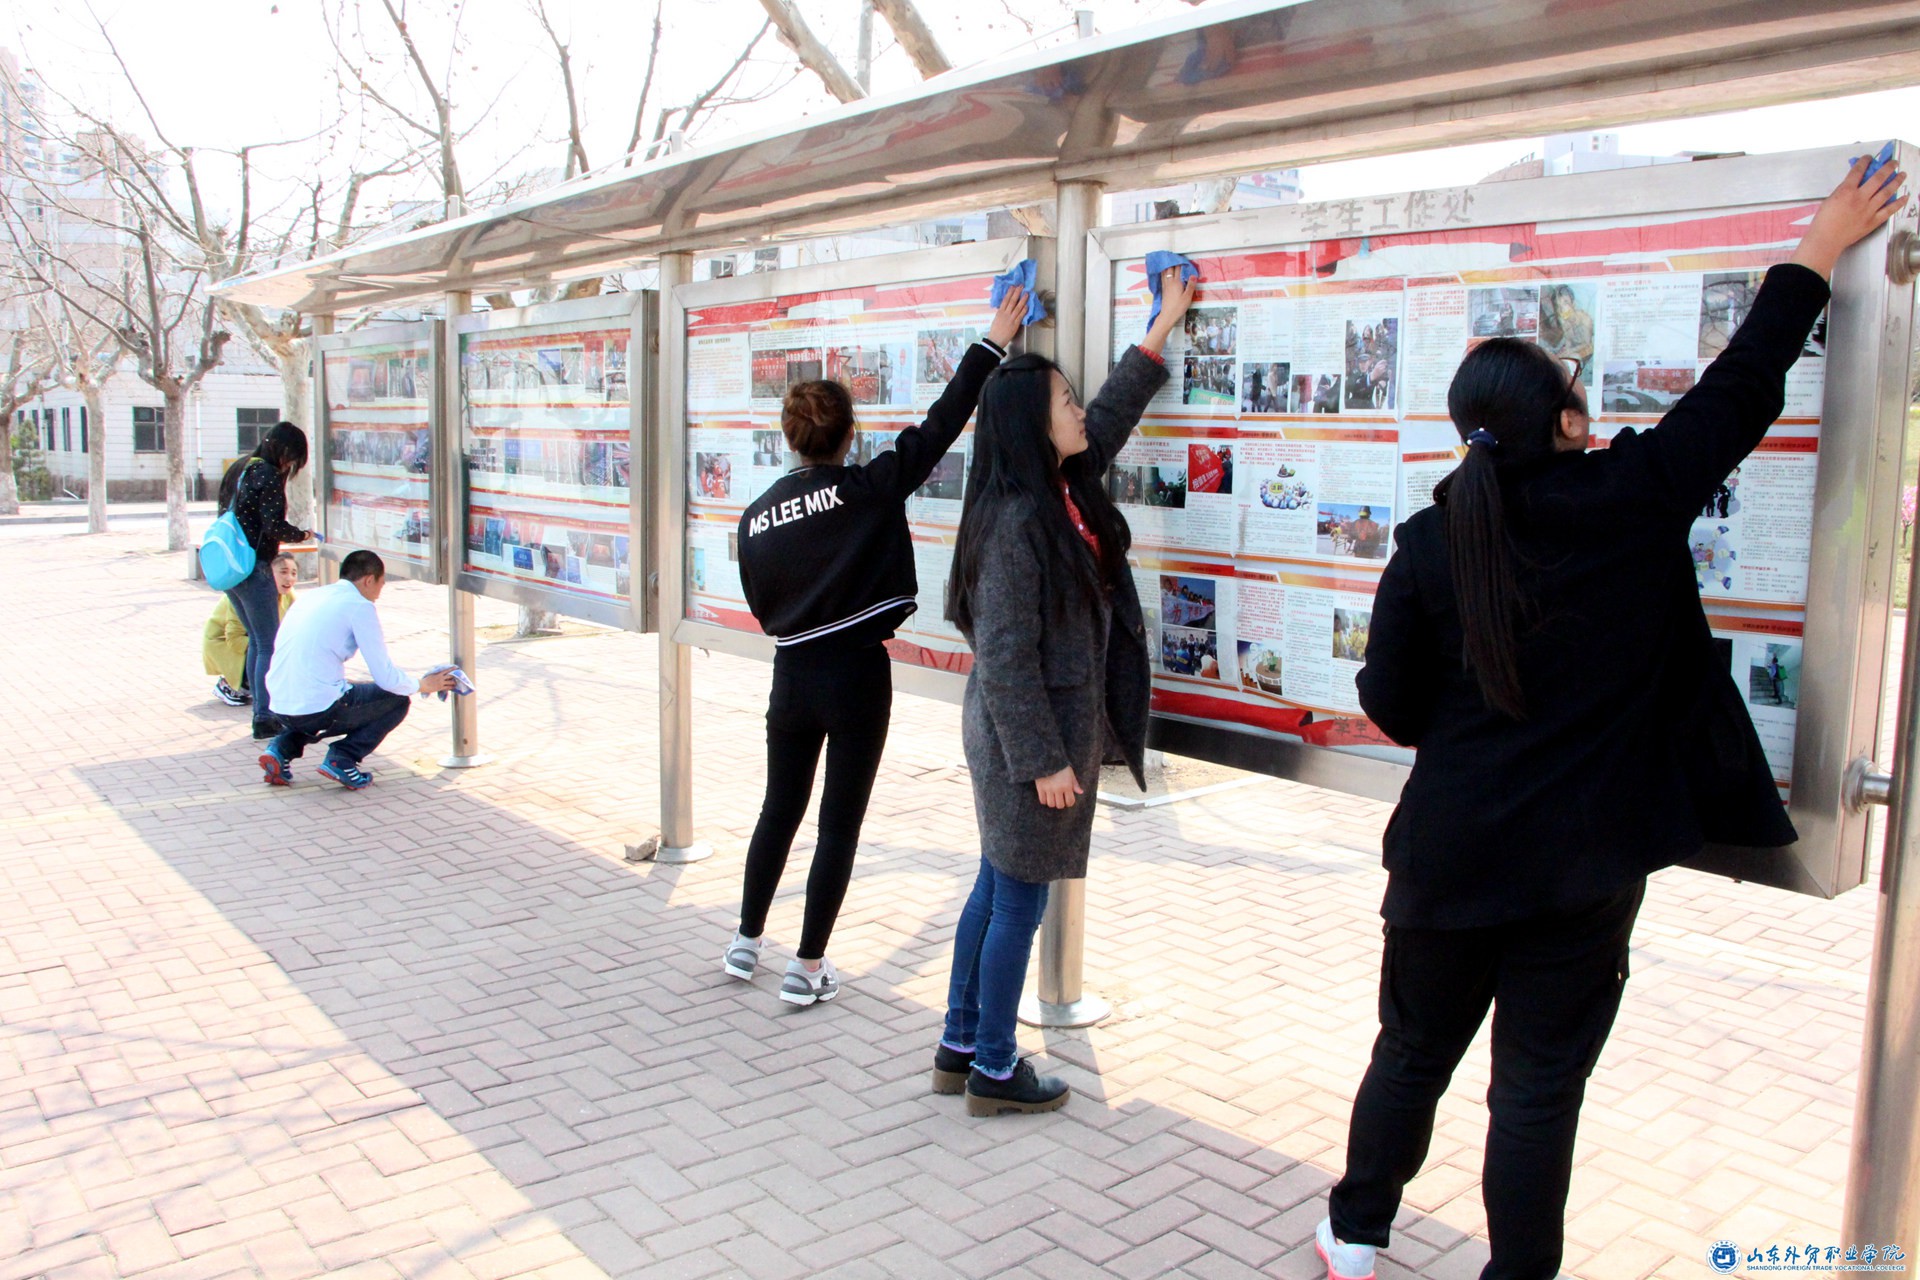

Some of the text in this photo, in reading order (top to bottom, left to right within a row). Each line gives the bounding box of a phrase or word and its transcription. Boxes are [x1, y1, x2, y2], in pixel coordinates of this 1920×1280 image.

[1300, 187, 1475, 236] 学生工作处
[749, 485, 844, 537] MS LEE MIX
